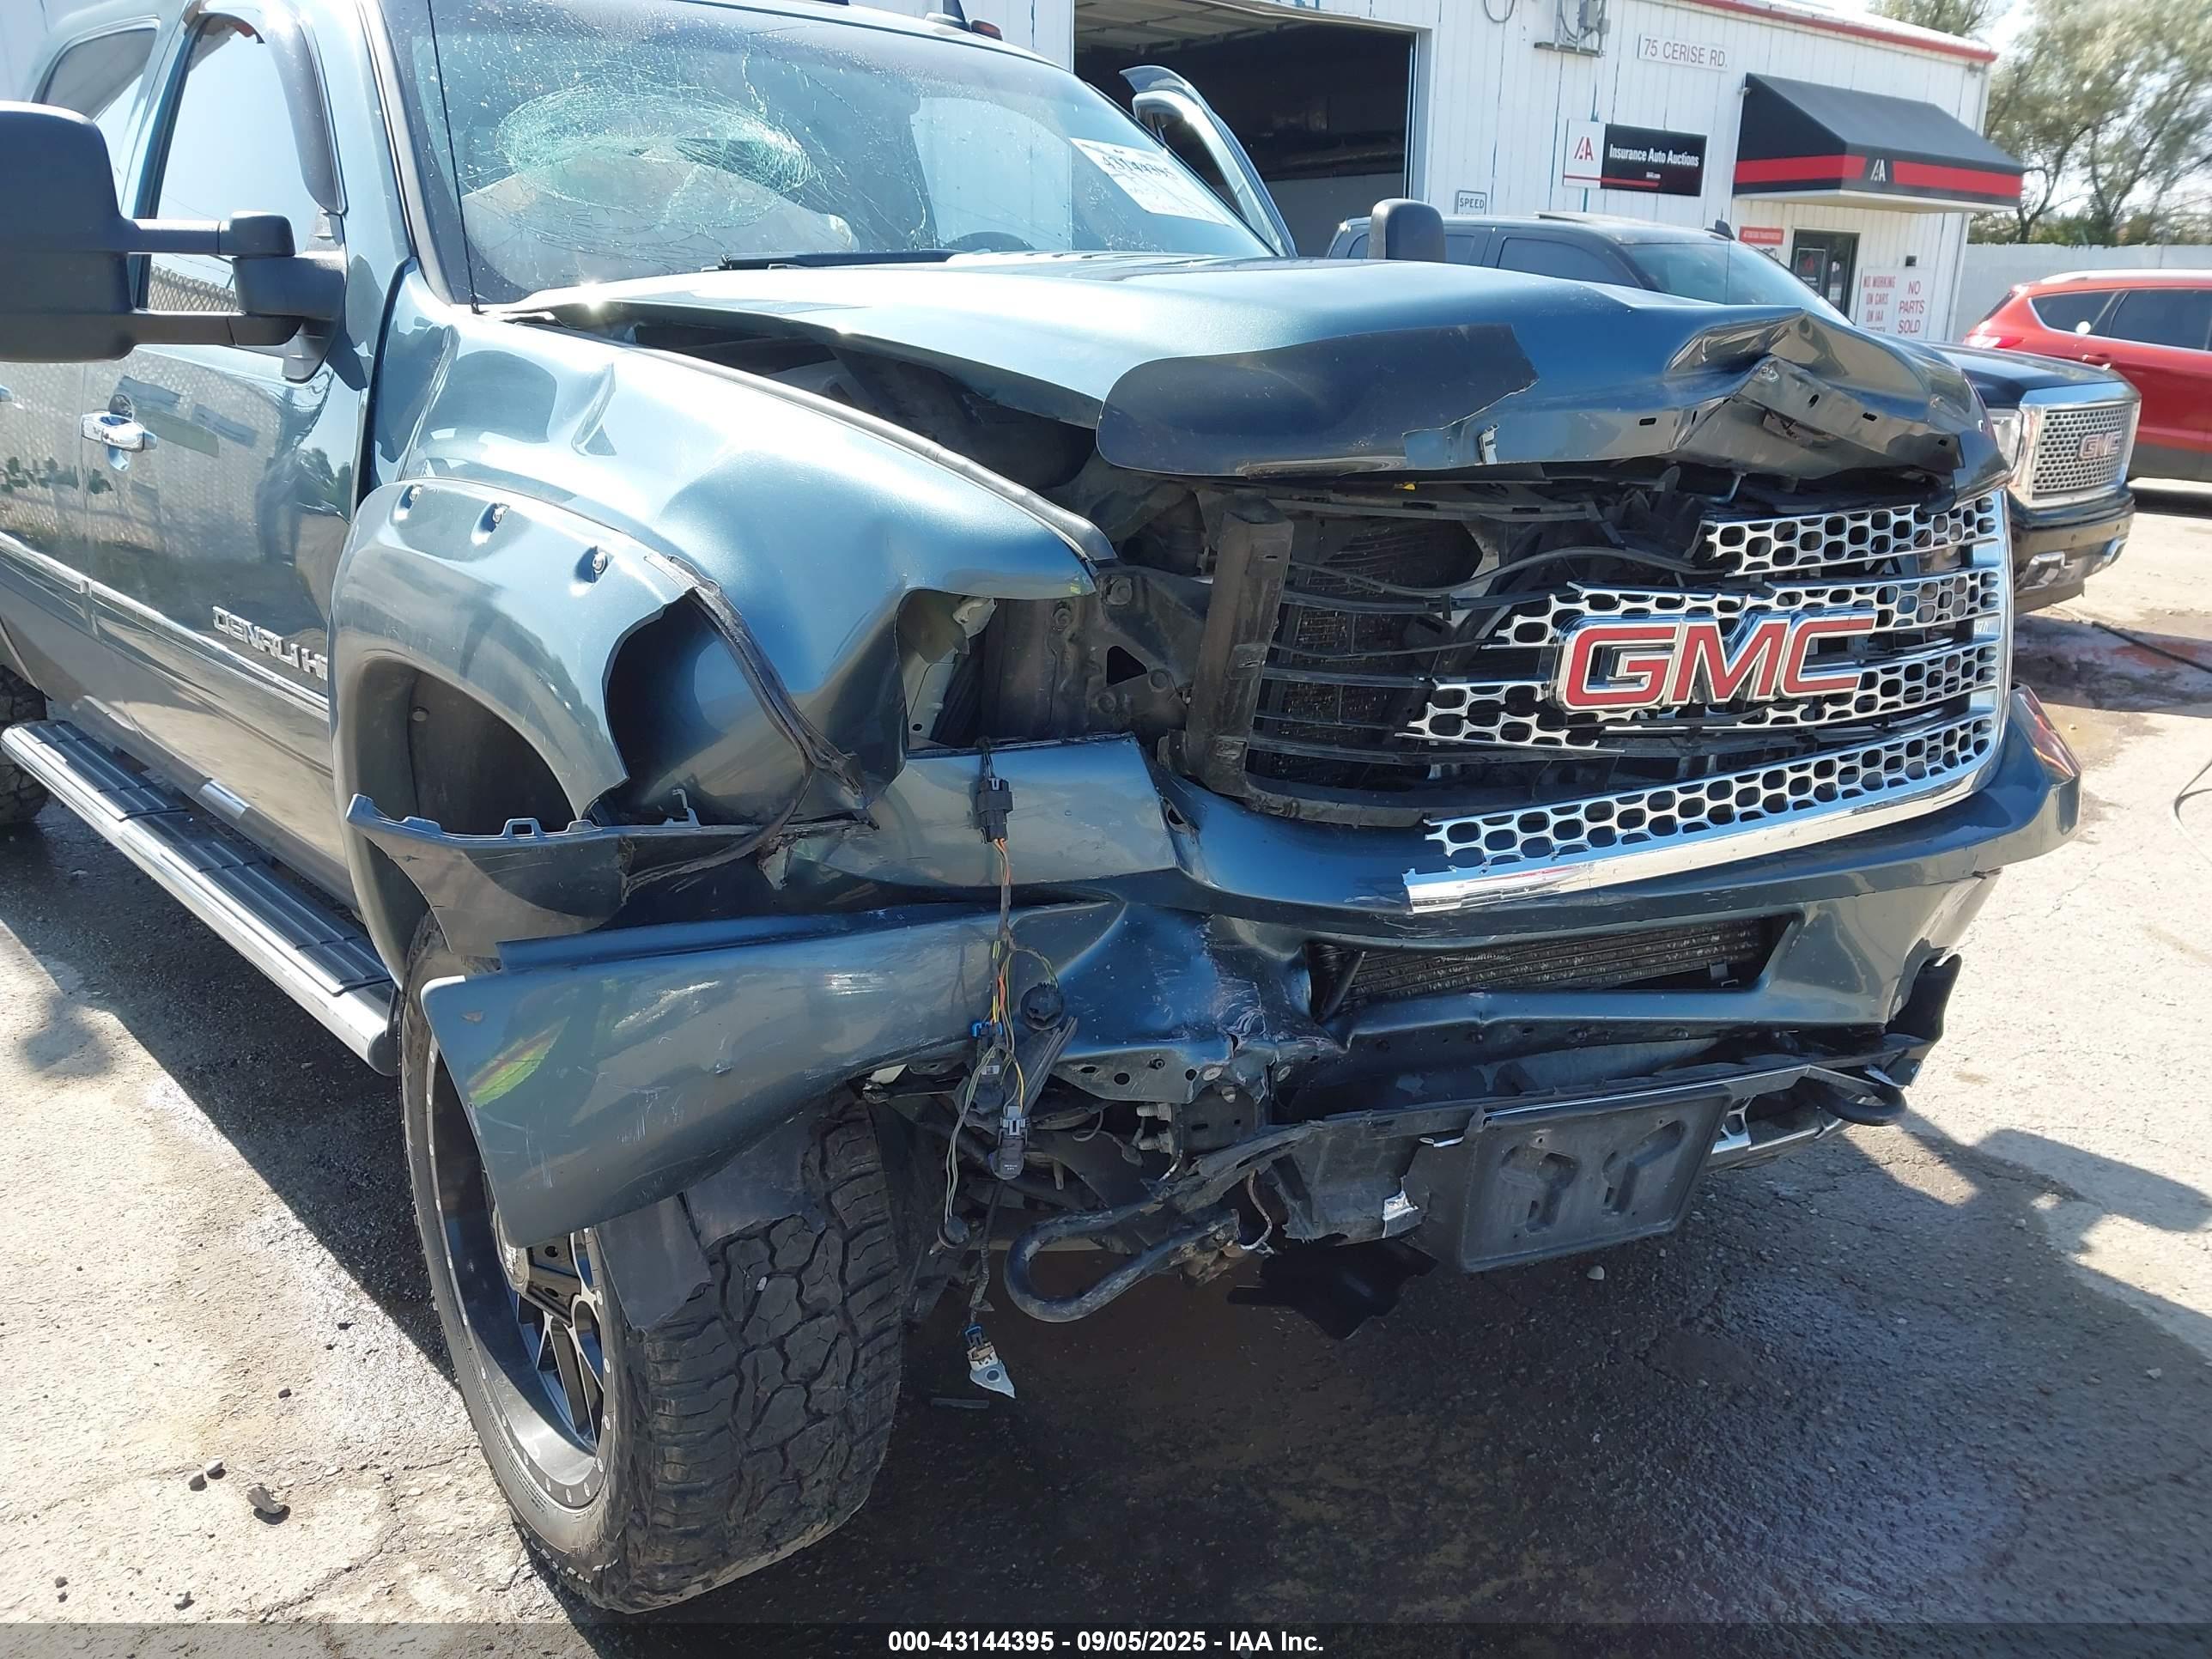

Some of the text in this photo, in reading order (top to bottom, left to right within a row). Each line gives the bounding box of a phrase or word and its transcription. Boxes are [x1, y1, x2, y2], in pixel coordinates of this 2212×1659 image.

[1644, 38, 1728, 68] 75 CERISE RD.
[1609, 143, 1699, 167] Insurance Auto Auctions
[1460, 198, 1485, 209] SPEED
[1908, 280, 1922, 295] NO
[1899, 300, 1924, 314] PARTS
[1898, 319, 1921, 334] SOLD
[2081, 431, 2122, 459] GMC
[213, 605, 300, 668] DENALI
[1556, 608, 1877, 712] GMC
